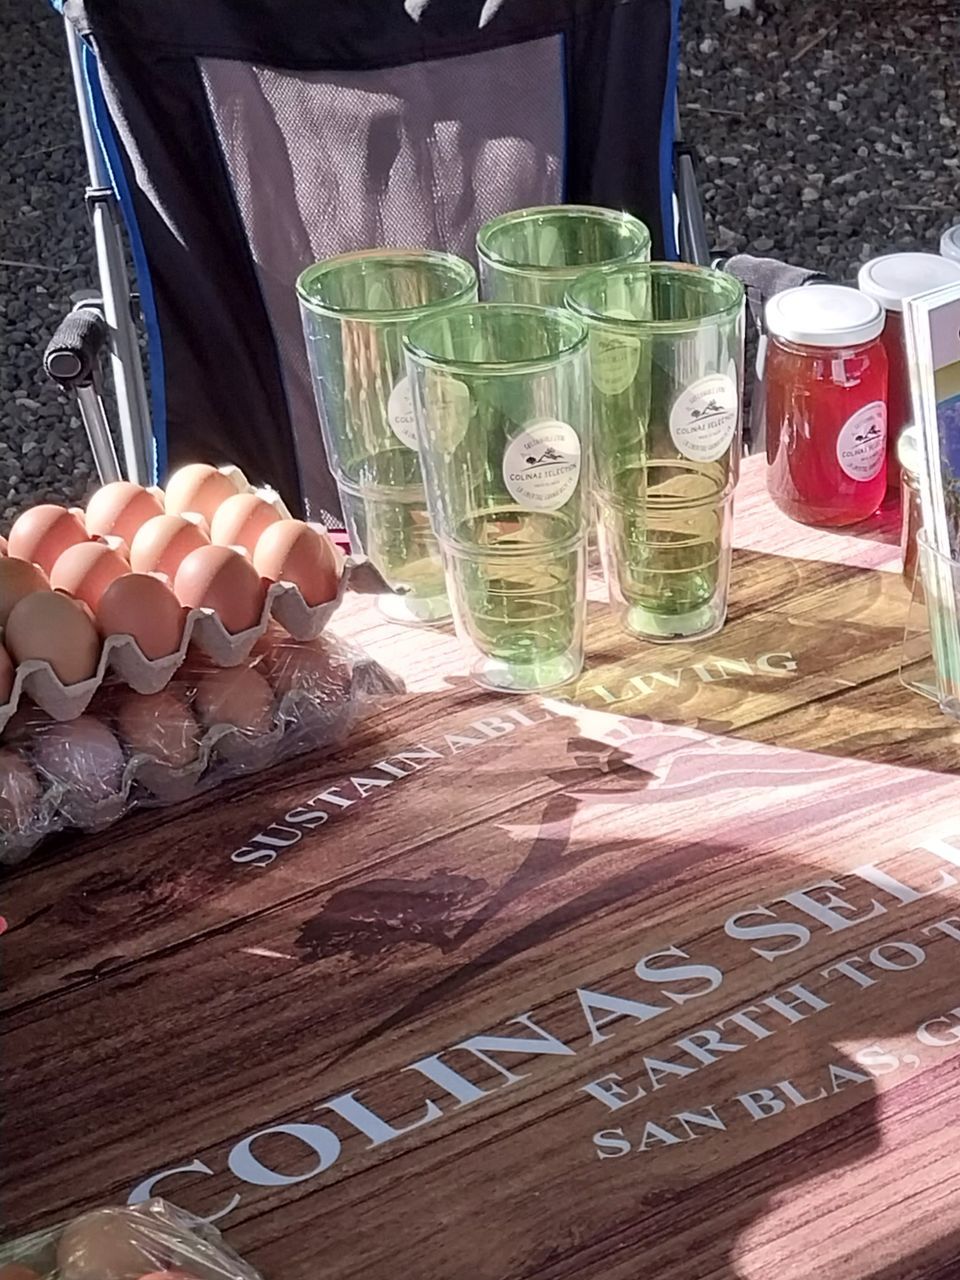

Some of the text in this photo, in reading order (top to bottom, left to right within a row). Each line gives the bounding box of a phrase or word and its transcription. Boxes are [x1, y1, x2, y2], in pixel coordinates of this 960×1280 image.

[588, 652, 800, 705] LIVING
[126, 945, 725, 1228] COLINAS
[582, 983, 830, 1113] EARTH
[820, 938, 928, 993] TO
[592, 1105, 729, 1161] SAN
[736, 1038, 922, 1125] BLAS,
